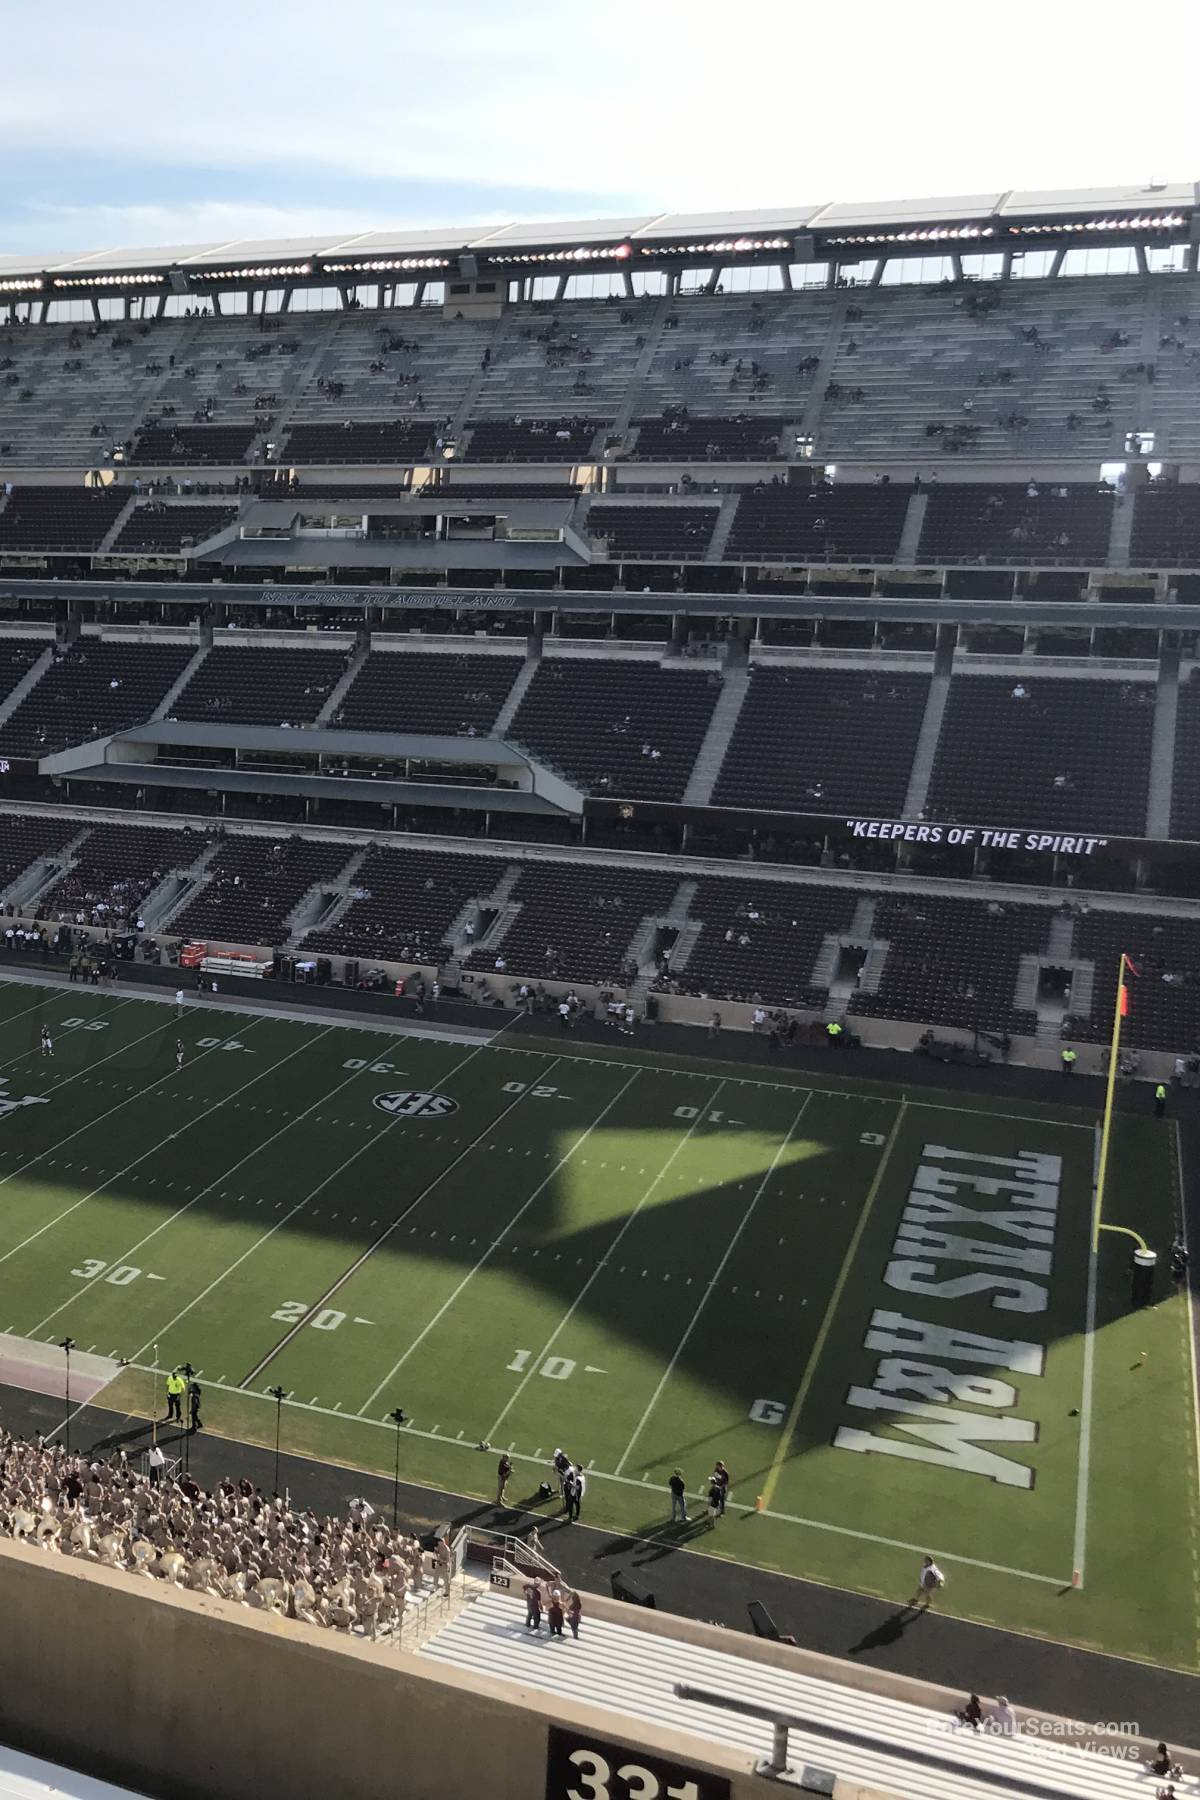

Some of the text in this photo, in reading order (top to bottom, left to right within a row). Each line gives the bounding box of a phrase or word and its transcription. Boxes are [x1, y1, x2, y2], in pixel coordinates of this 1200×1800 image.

[260, 591, 359, 604] WELCOME
[391, 594, 518, 608] AGGIELAND
[846, 821, 1108, 856] "KEEPERS OF THE SPIRIT"
[59, 1017, 110, 1031] 50
[194, 1037, 245, 1051] 40
[341, 1058, 396, 1074] 30
[500, 1081, 559, 1098] 20
[378, 1091, 454, 1116] SEC
[672, 1105, 725, 1122] 10
[70, 1258, 143, 1286] 30
[269, 1300, 347, 1331] 20
[831, 1142, 1063, 1491] TEXAS A&M
[505, 1349, 577, 1380] 10
[748, 1398, 787, 1425] G
[492, 1576, 508, 1586] 123
